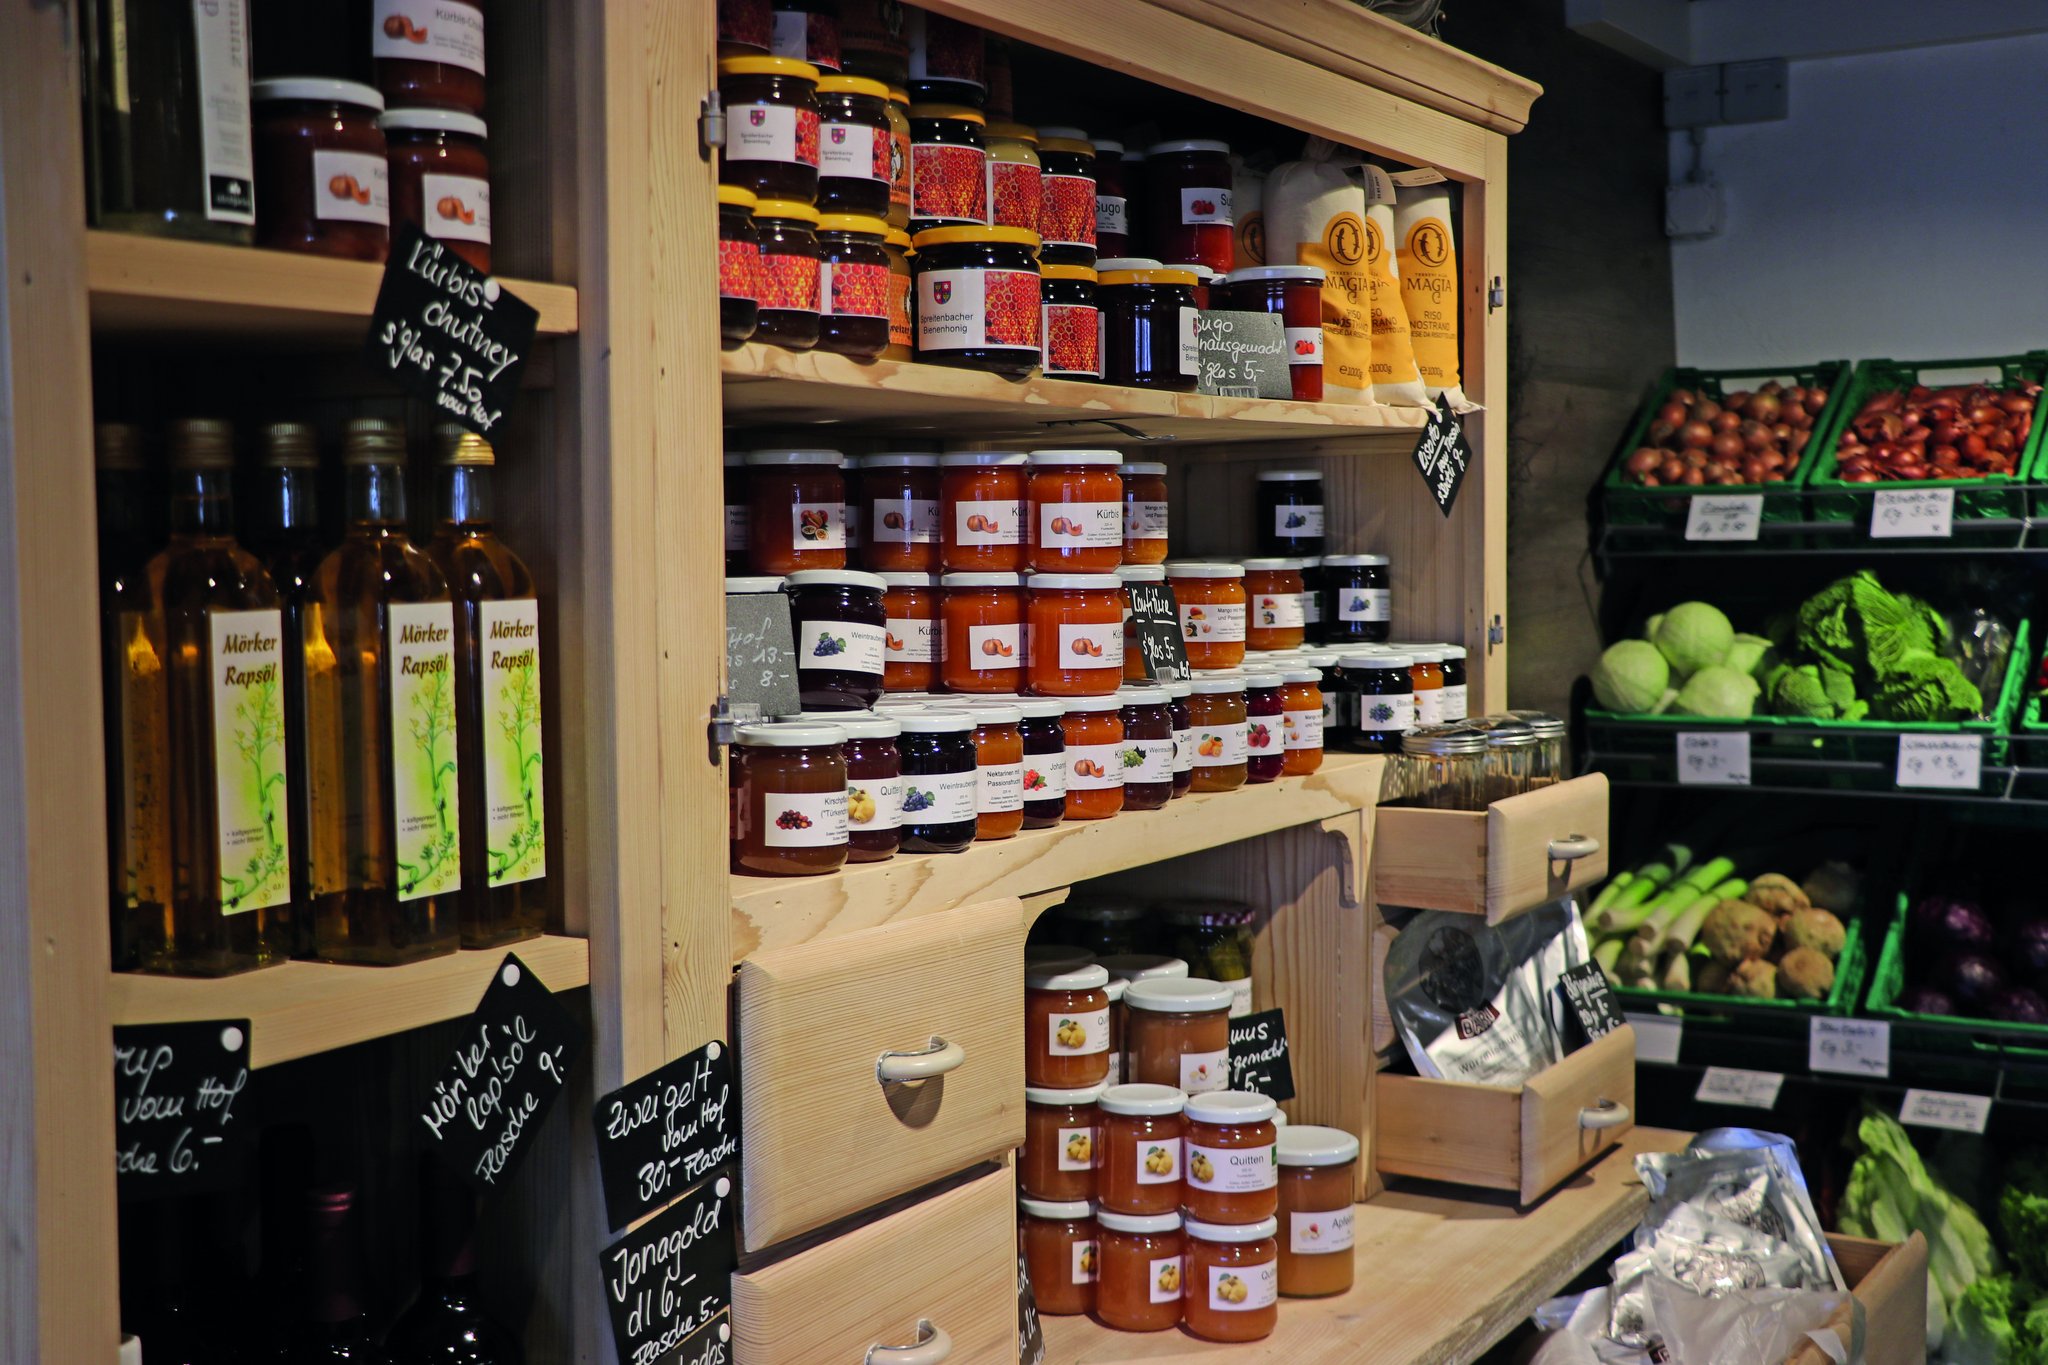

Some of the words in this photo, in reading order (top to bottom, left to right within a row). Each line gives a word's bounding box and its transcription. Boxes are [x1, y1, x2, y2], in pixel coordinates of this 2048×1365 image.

[1325, 275, 1369, 296] MAGIA
[1406, 277, 1453, 297] MAGIA
[920, 313, 973, 324] Spreitenbacher
[1423, 310, 1442, 321] RISO
[923, 325, 968, 335] Bienenhonig
[400, 621, 450, 645] Mörker
[490, 619, 536, 641] Mörker
[222, 632, 278, 655] Mörker
[401, 653, 448, 679] Rapsöl
[491, 646, 535, 672] Rapsöl
[224, 662, 278, 690] Rapsöl
[195, 1067, 248, 1126] Hof
[606, 1058, 713, 1140] Zweigelt
[701, 1083, 729, 1133] Hof
[475, 1093, 540, 1185] Flasche
[1229, 1154, 1264, 1167] Quitten
[611, 1197, 722, 1303] Jonagold
